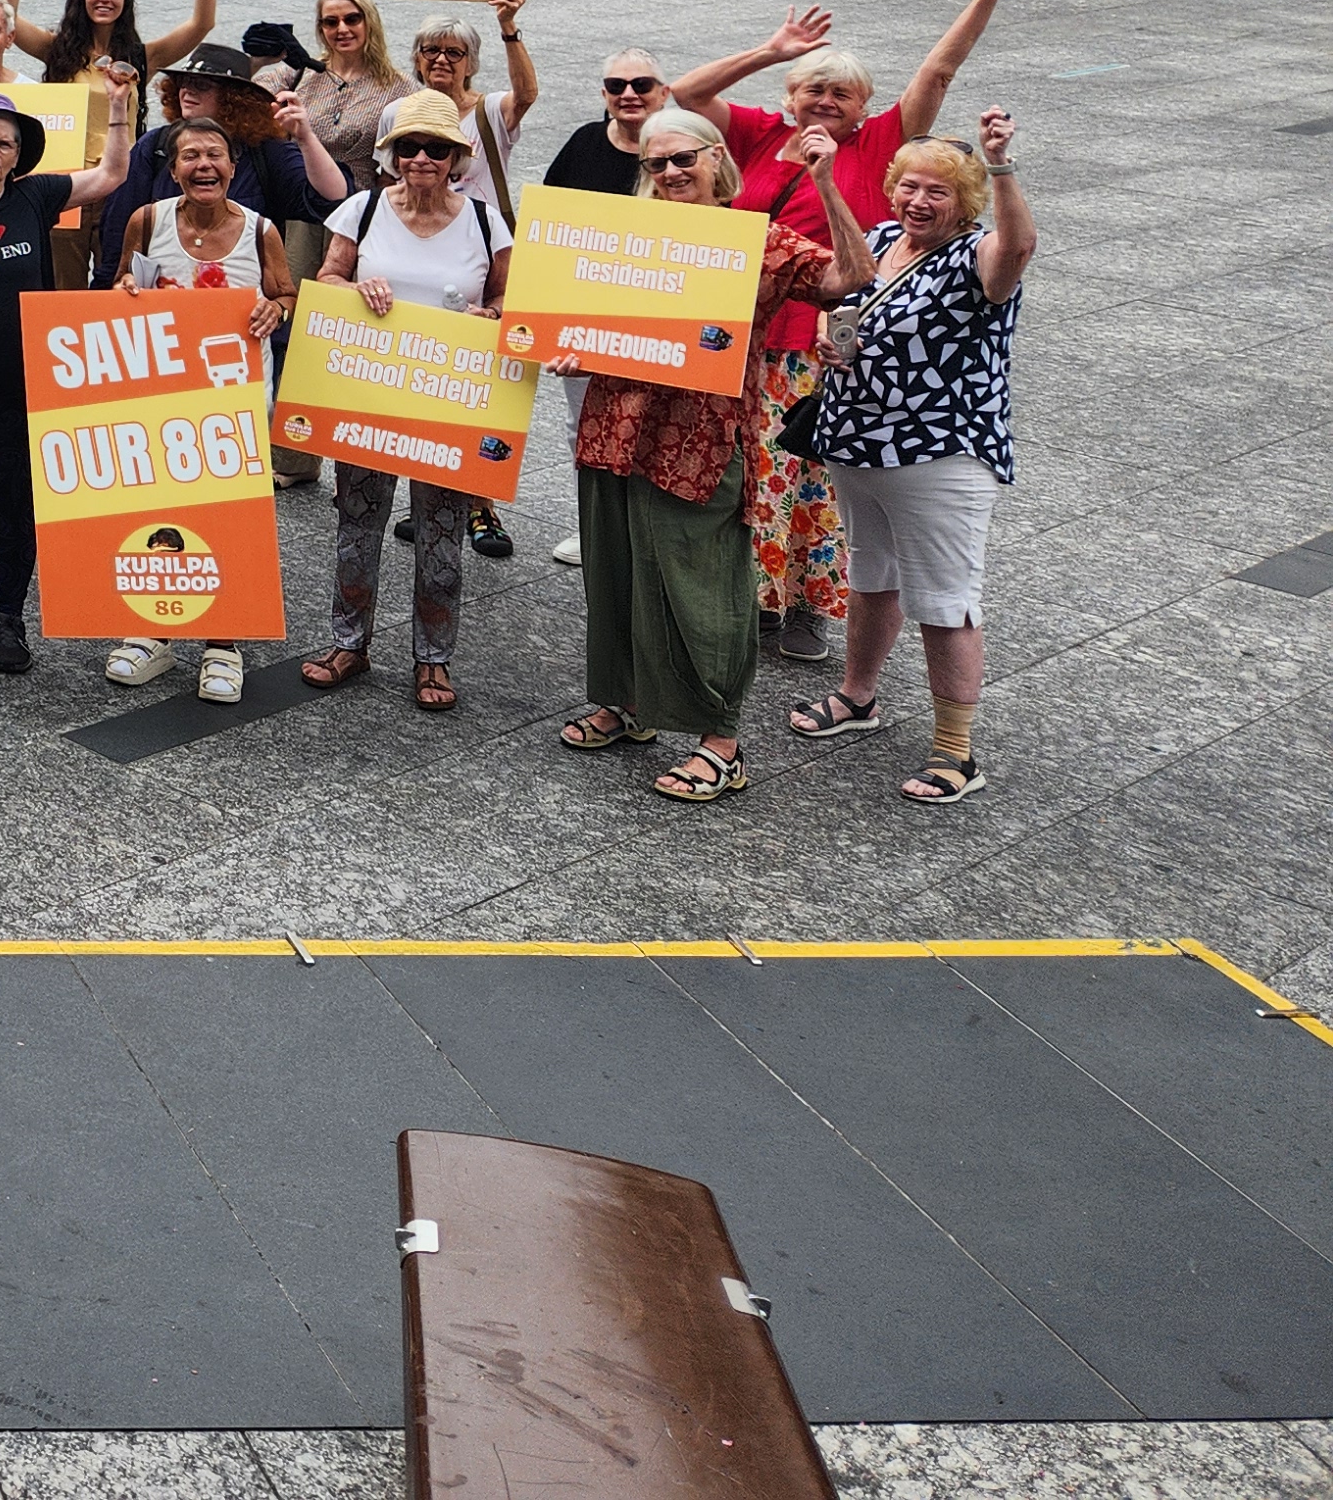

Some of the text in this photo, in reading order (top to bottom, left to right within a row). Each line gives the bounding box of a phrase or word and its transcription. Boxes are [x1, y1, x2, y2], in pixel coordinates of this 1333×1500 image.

[2, 242, 31, 259] END
[526, 218, 748, 273] A Lifeline for Tangara
[573, 255, 686, 295] Residents!
[47, 311, 186, 389] SAVE
[306, 311, 524, 382] Helping Kids get to
[557, 325, 687, 368] #SAVEOUR86
[326, 348, 491, 410] School Safely!
[40, 411, 263, 494] OUR 86!
[332, 421, 463, 471] #SAVEOUR86
[114, 556, 219, 575] KURILPA
[116, 575, 221, 592] BUS LOOP
[155, 601, 184, 616] 86
